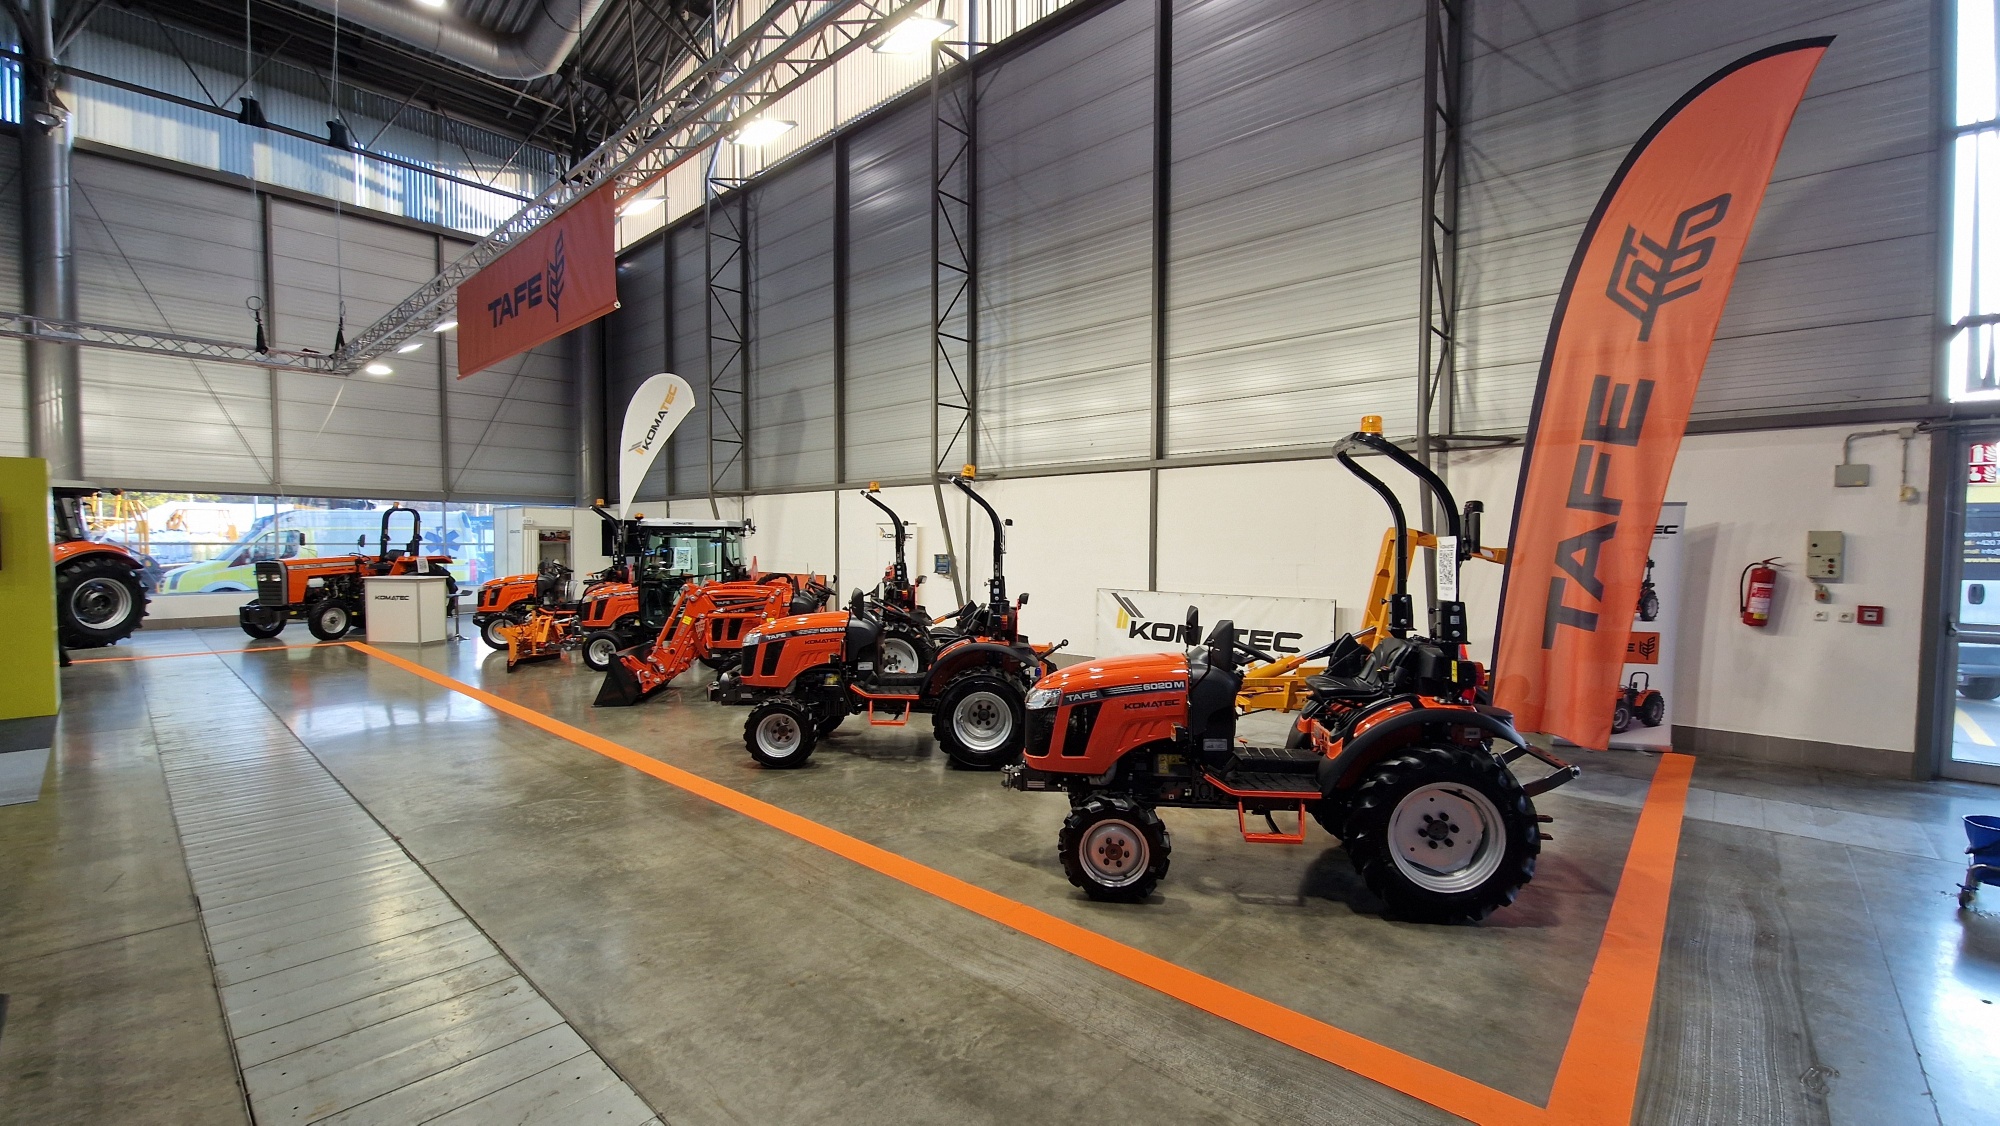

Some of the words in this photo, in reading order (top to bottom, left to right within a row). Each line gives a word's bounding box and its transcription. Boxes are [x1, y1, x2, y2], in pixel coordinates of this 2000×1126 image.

[488, 272, 543, 328] TAFE
[642, 383, 678, 451] KOMATEC
[1542, 374, 1656, 650] TAFE
[804, 637, 840, 645] KOMATEC
[1066, 690, 1098, 702] TAFE
[1143, 682, 1173, 691] 6020
[1174, 681, 1185, 689] M
[1124, 699, 1181, 710] KOMATEC
